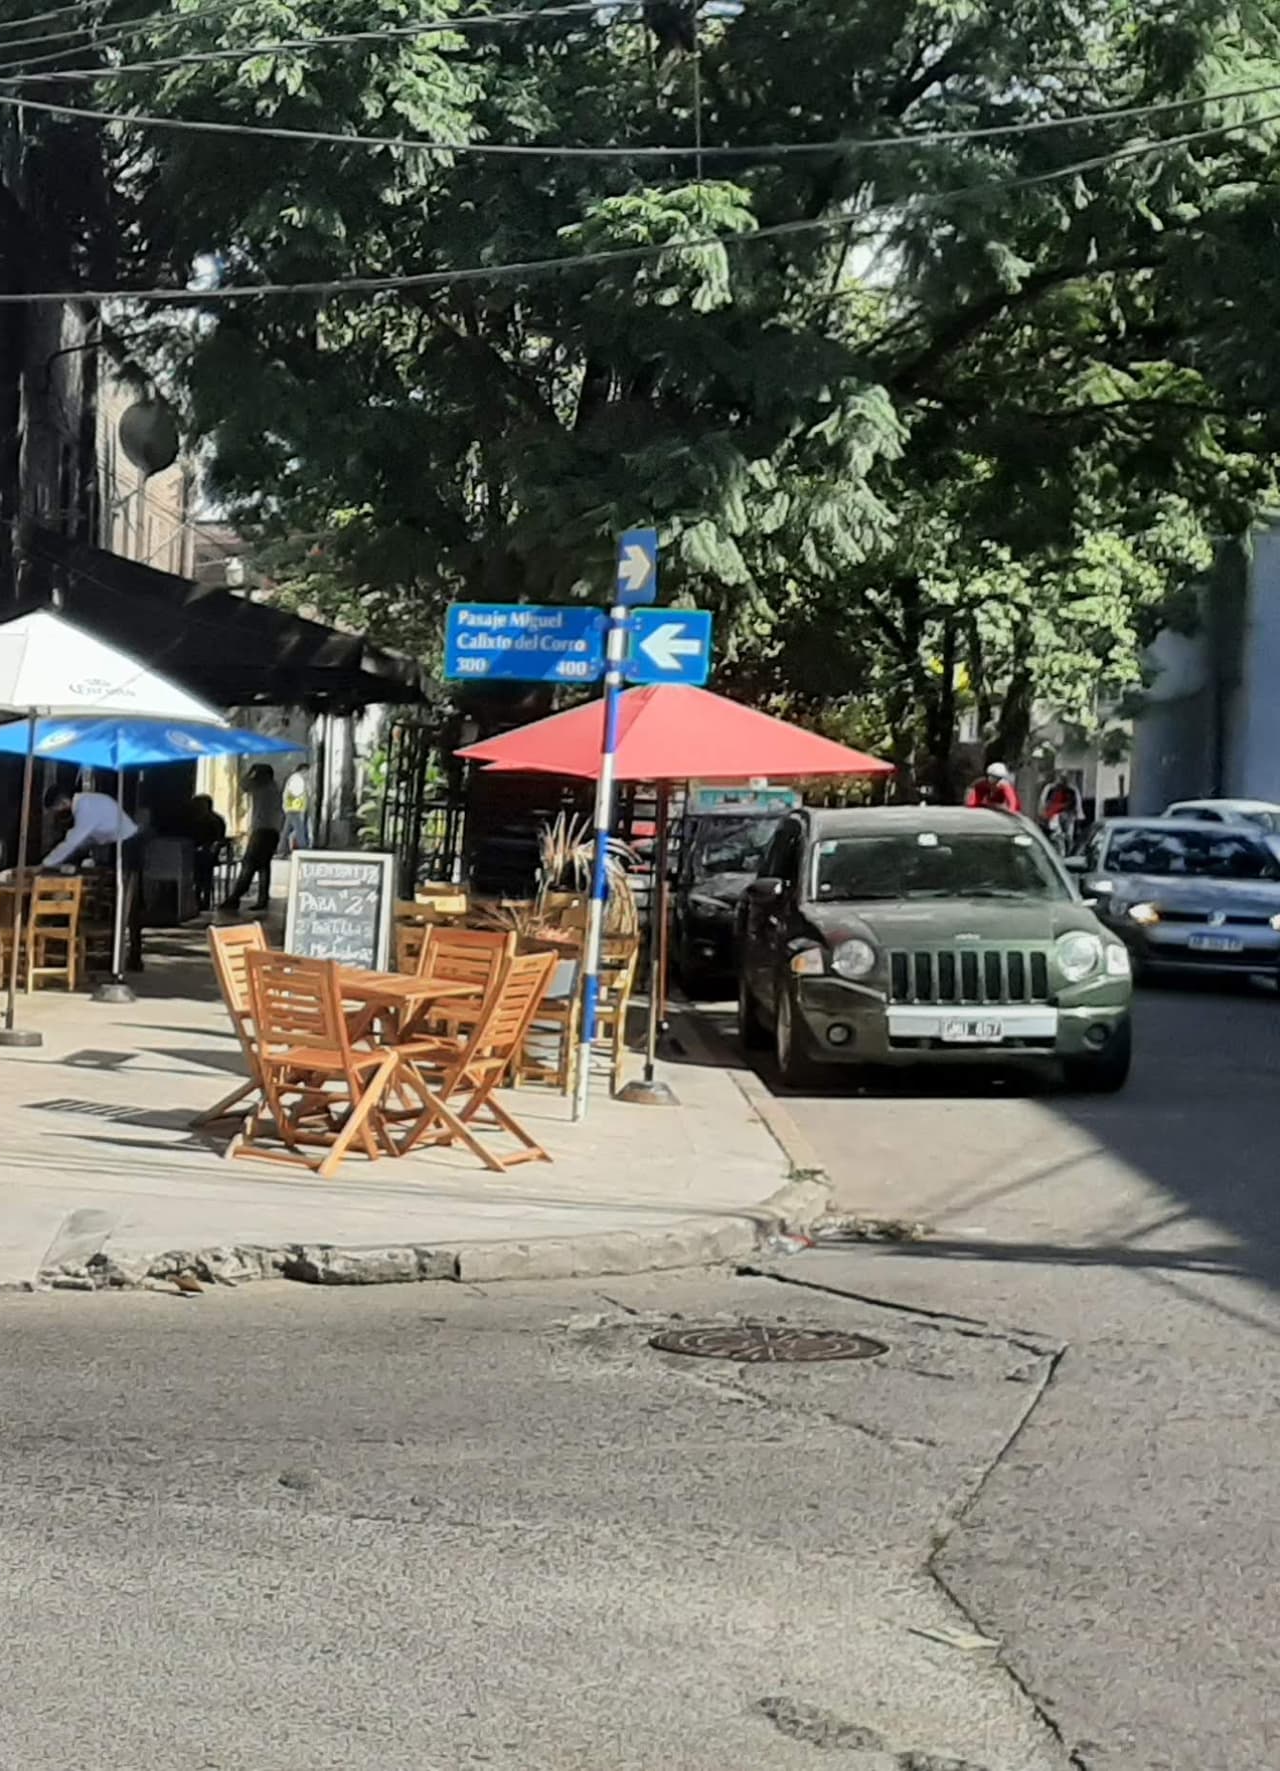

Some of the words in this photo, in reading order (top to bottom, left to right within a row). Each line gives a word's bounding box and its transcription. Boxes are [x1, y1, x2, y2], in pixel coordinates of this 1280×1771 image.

[457, 610, 508, 631] Pasaje
[509, 610, 563, 632] Miguel
[456, 631, 513, 650] Calixto
[514, 634, 539, 651] del
[540, 635, 588, 652] Corro
[456, 656, 487, 673] 300
[555, 660, 588, 676] 400
